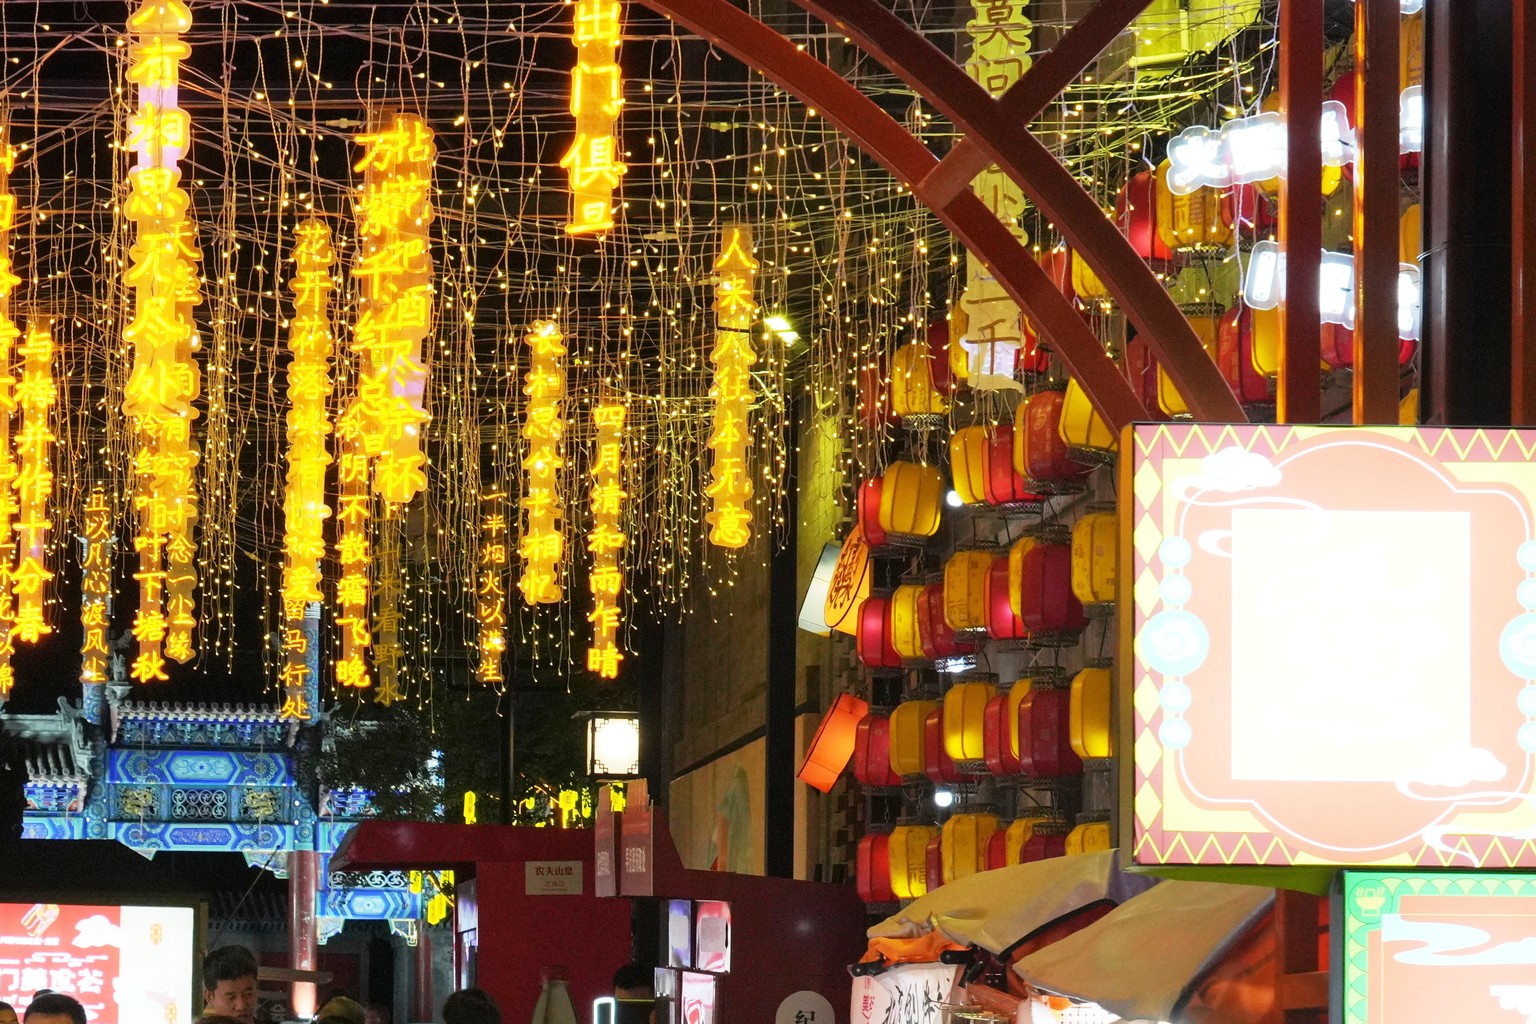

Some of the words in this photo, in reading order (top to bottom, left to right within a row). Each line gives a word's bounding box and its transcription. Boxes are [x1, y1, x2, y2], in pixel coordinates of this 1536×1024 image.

[10, 328, 54, 643] 与梅并作十分春
[522, 325, 565, 604] 长相思兮长相忆
[713, 228, 756, 548] 人来人往本无意
[336, 403, 370, 689] 秋阴不散霜飞晚
[479, 492, 506, 683] 一半烟火以谋生
[587, 403, 626, 680] 四月清和雨乍晴
